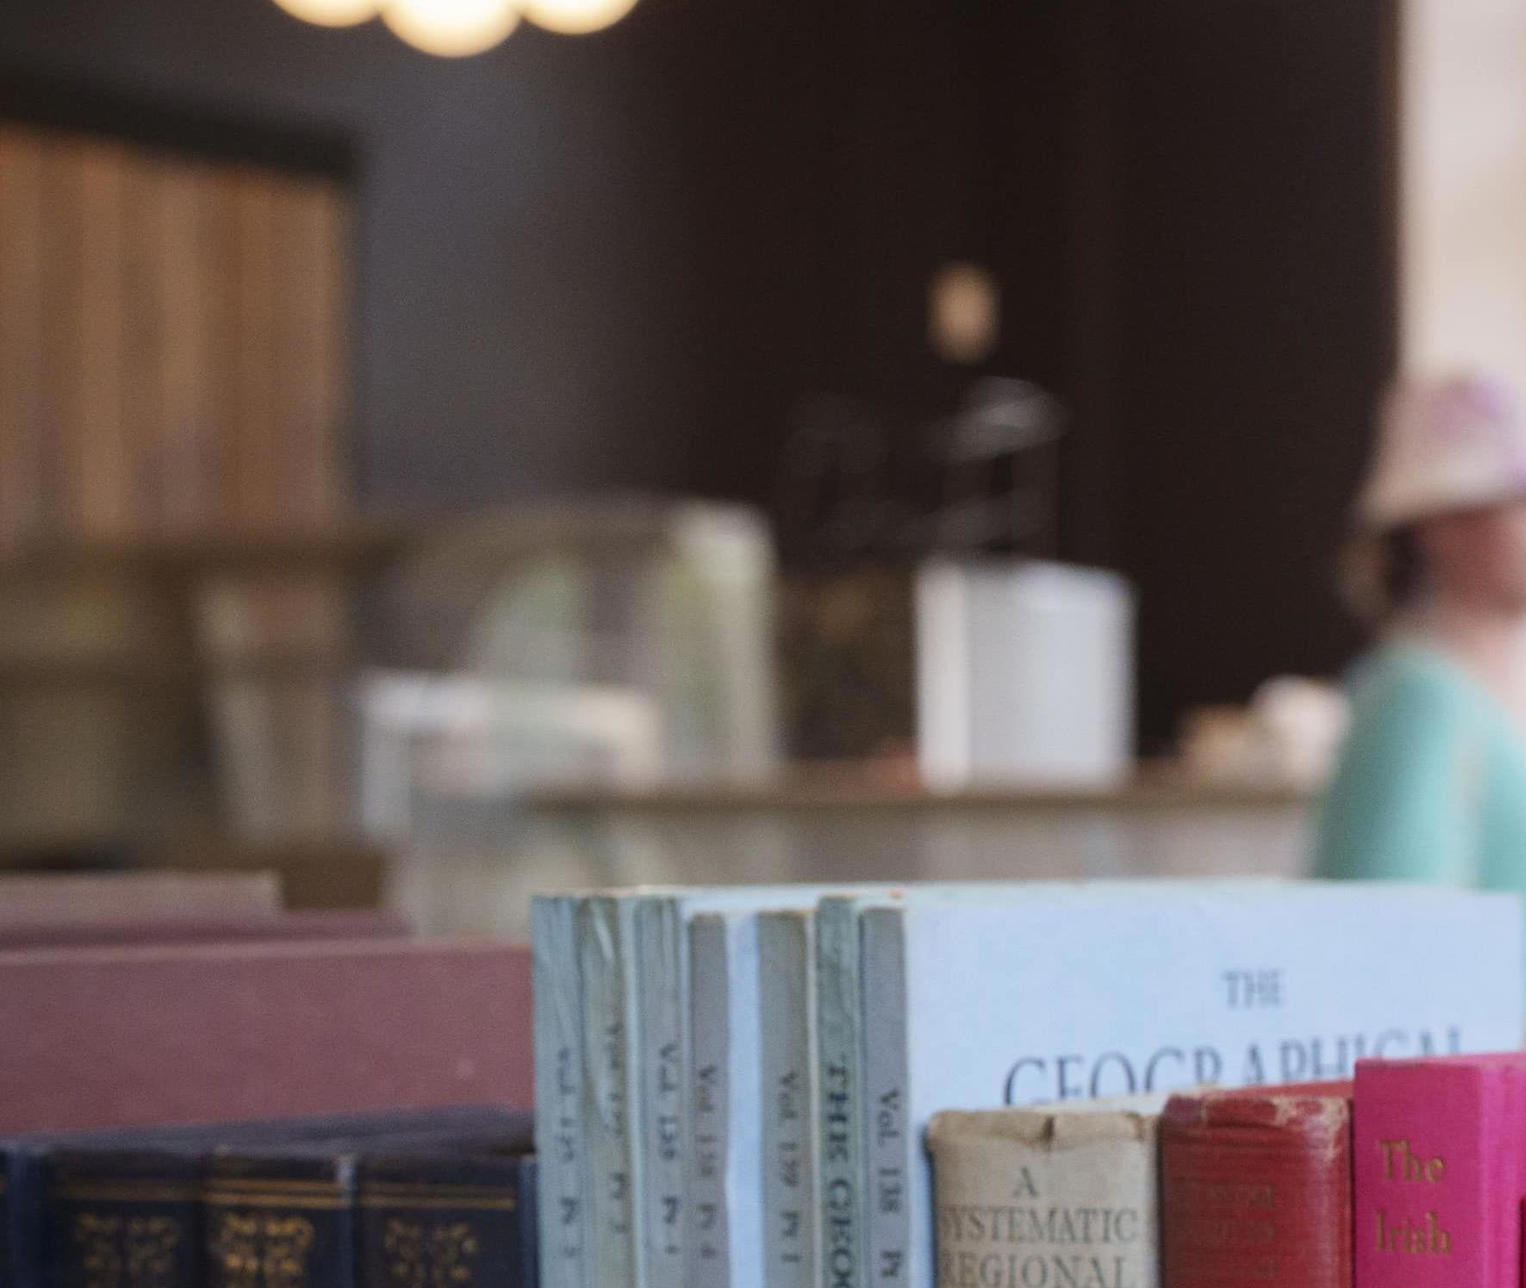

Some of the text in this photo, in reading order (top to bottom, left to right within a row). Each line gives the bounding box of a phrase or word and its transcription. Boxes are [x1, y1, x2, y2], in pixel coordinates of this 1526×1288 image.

[1221, 969, 1284, 1009] THE
[822, 1061, 853, 1163] THE
[1012, 1166, 1039, 1197] A
[1377, 1139, 1447, 1183] The
[1374, 1210, 1453, 1255] Irish
